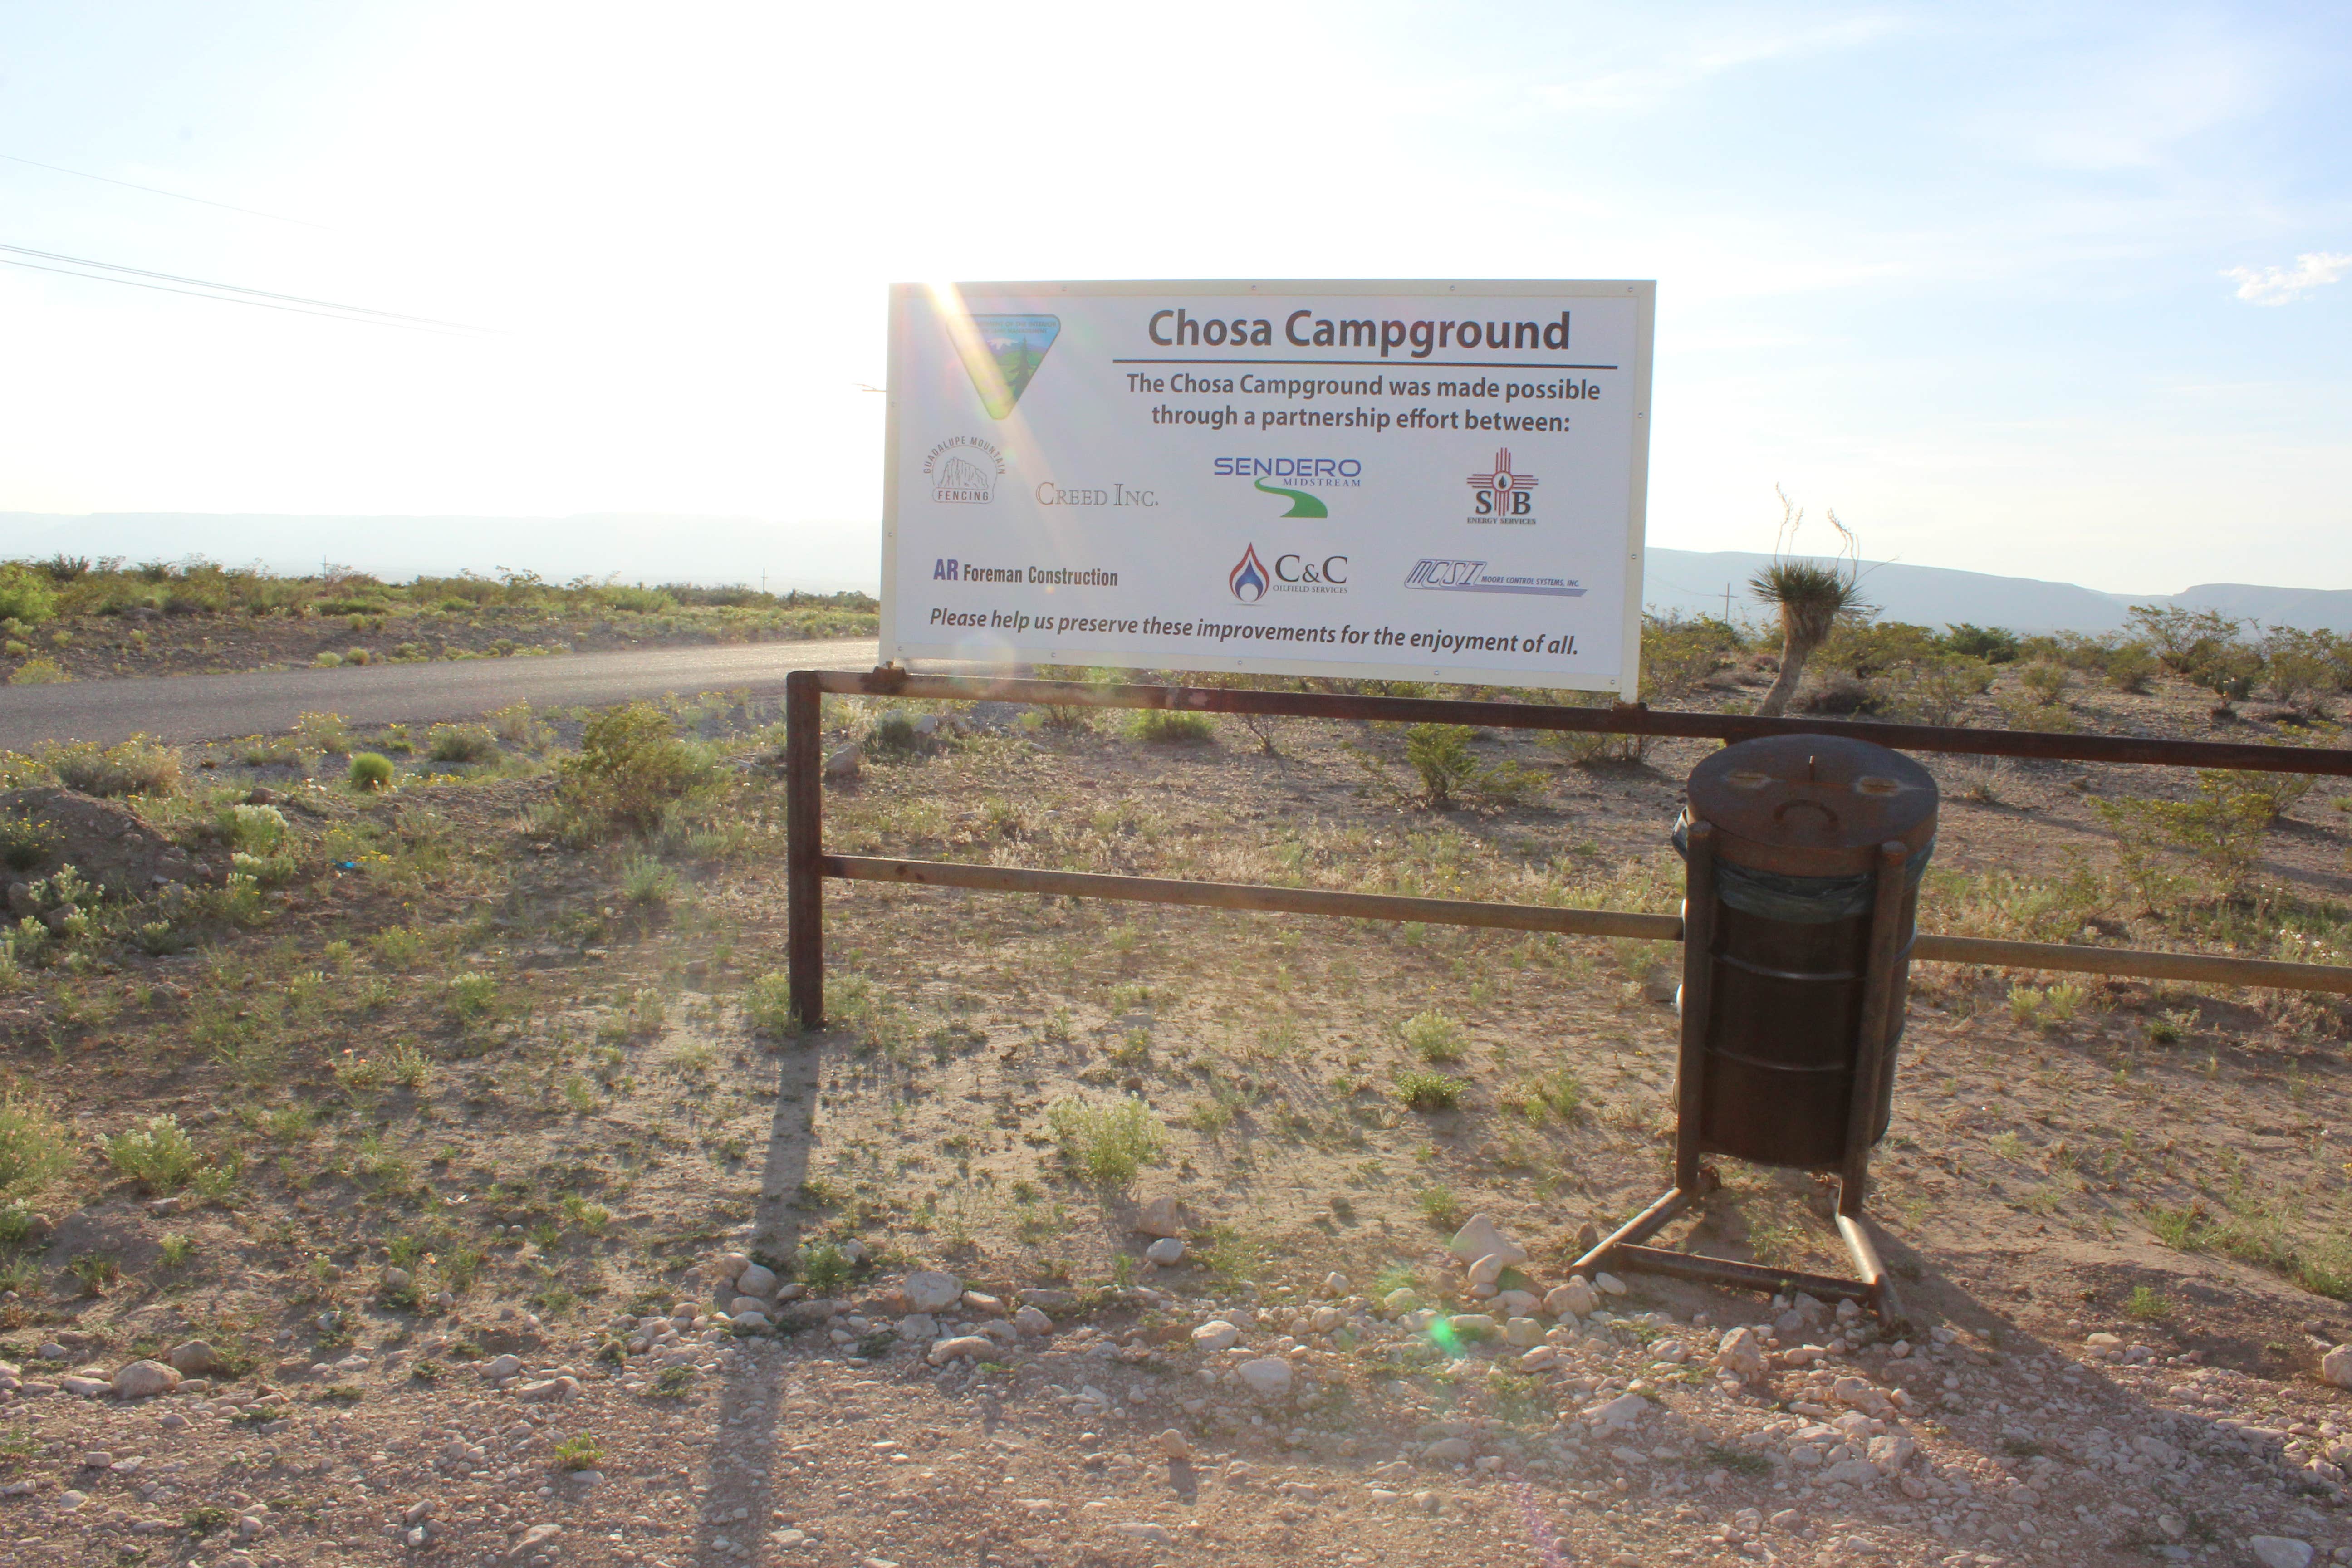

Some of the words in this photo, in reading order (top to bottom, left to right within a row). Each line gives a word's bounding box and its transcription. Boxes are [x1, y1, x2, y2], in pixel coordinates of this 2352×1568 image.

[1148, 309, 1272, 347] Chosa
[1285, 310, 1571, 358] Campground
[1127, 372, 1165, 393] The
[1171, 373, 1234, 393] Chosa
[1240, 374, 1383, 400] Campground
[1389, 381, 1431, 397] was
[1437, 377, 1499, 398] made
[1506, 378, 1601, 402] possible
[1152, 404, 1238, 431] through
[1244, 411, 1255, 425] a
[1262, 407, 1391, 433] partnership
[1396, 407, 1459, 430] effort
[1465, 409, 1570, 432] between:
[923, 436, 966, 474] GUADALUPE
[970, 436, 1006, 474] MOUNTAIN
[1214, 457, 1362, 478] SENDERO
[1283, 478, 1361, 487] MIDSTREAM
[937, 490, 989, 501] FENCING
[1467, 516, 1497, 524] ENERGY
[1499, 517, 1536, 525] SERVICES
[933, 559, 959, 581] AR
[963, 564, 1023, 583] Foreman
[1028, 566, 1118, 586] Construction
[1275, 554, 1348, 584] C&C
[1407, 561, 1484, 585] MCSI
[1273, 584, 1309, 593] OILFIELD
[1312, 586, 1348, 594] SERVICES
[1506, 577, 1534, 585] CONTROL
[1536, 578, 1565, 587] SYSTEMS,
[930, 608, 987, 627] Please
[990, 609, 1030, 633] help
[1034, 616, 1054, 630] us
[1057, 617, 1138, 635] preserve
[1142, 616, 1193, 636] these
[1196, 618, 1336, 643] improvements
[1340, 625, 1370, 645] for
[1374, 626, 1406, 646] the
[1410, 629, 1519, 654] enjoyment
[1522, 633, 1546, 653] of
[1548, 635, 1578, 655] all.
